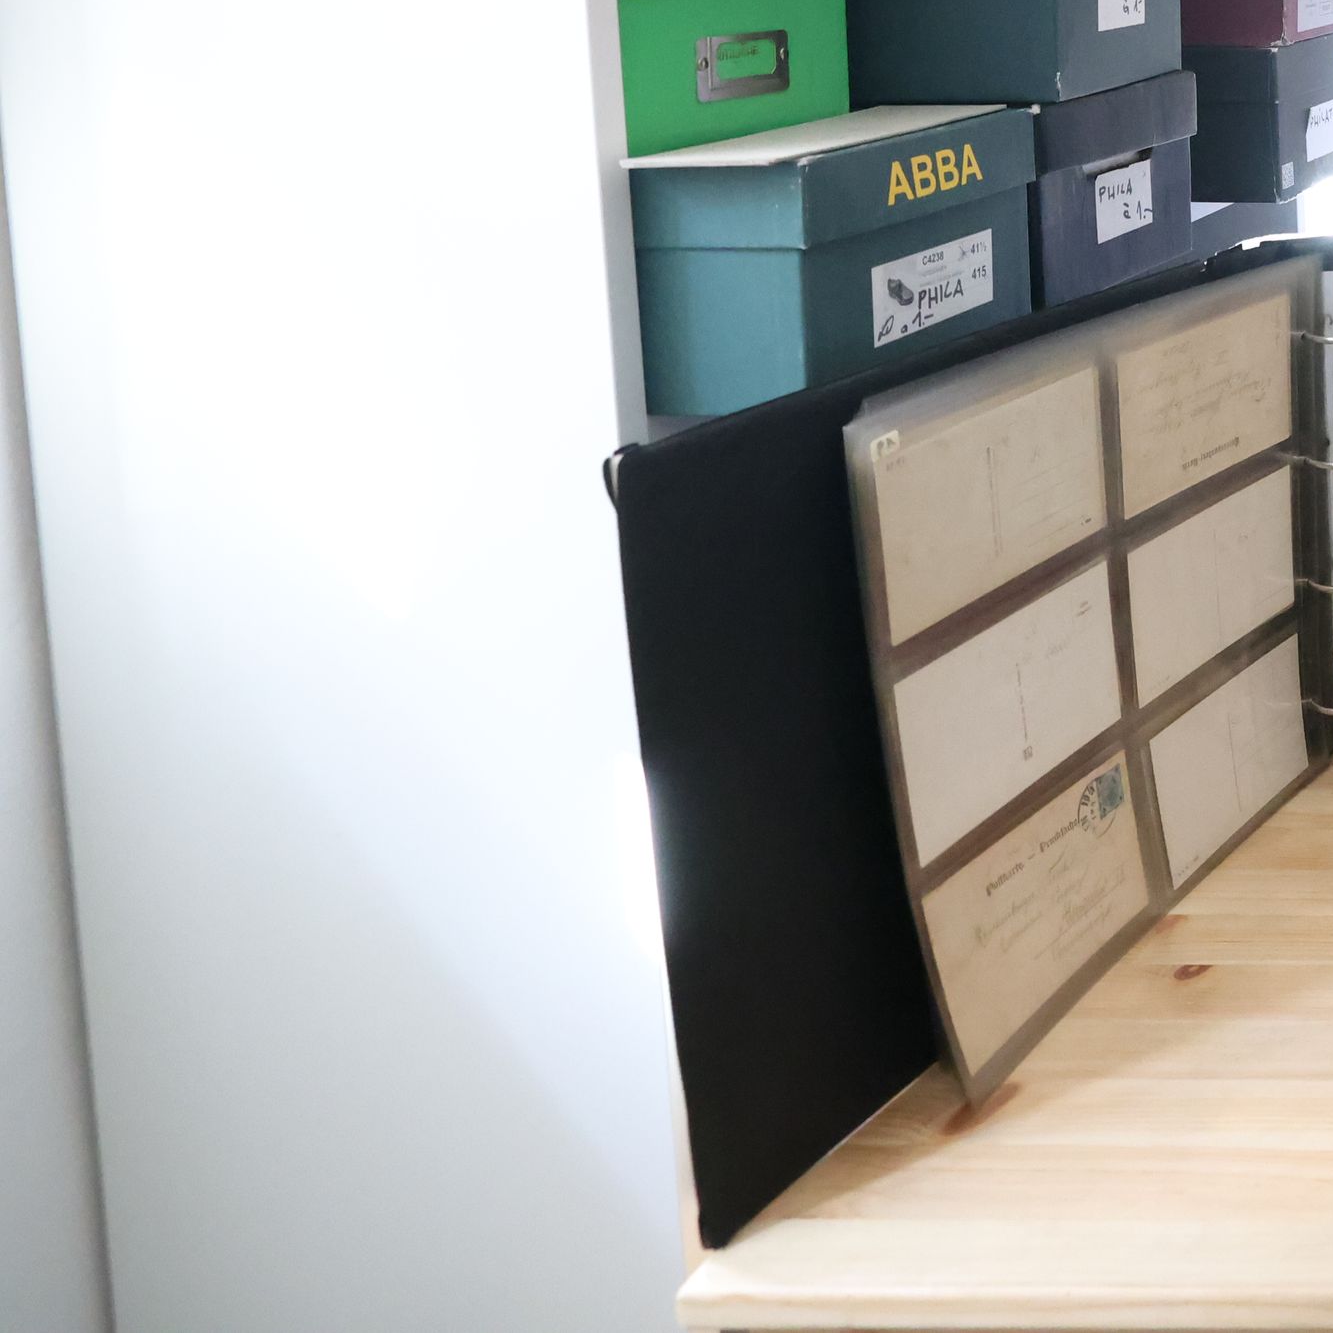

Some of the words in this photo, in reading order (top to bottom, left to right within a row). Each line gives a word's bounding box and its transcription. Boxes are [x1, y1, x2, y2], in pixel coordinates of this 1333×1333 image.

[887, 143, 984, 206] ABBA
[1099, 178, 1133, 203] PHILA
[922, 251, 944, 266] C4238
[971, 266, 987, 280] 415
[917, 279, 965, 310] PHILA
